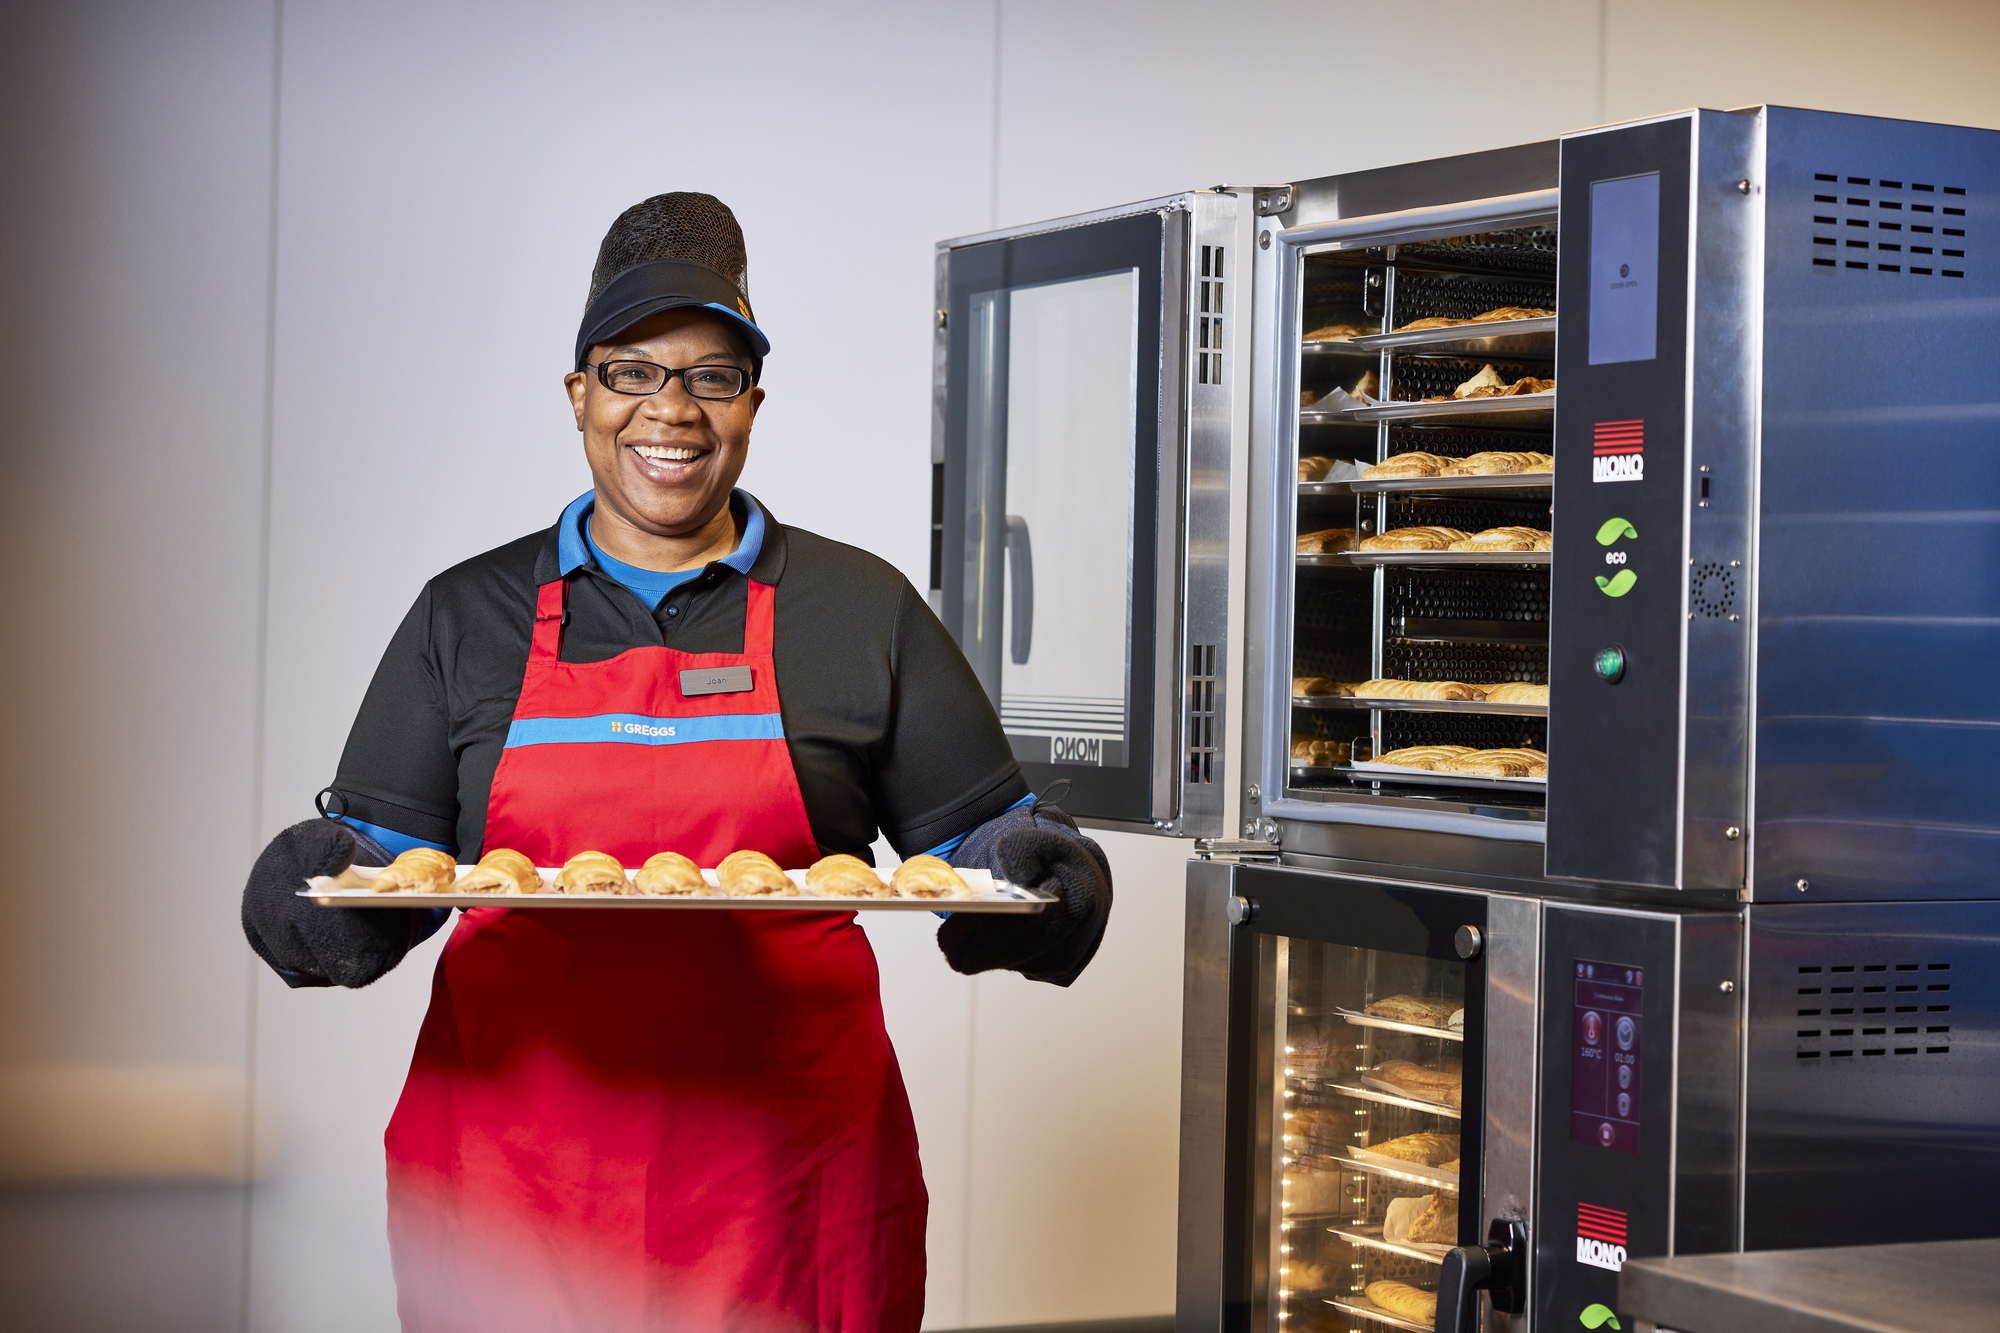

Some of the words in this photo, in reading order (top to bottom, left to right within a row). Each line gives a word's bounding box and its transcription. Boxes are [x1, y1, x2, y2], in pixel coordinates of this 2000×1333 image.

[1593, 453, 1644, 482] MONO
[1605, 551, 1627, 565] eco
[707, 677, 727, 685] Joan
[624, 723, 676, 736] GREGGS
[1581, 1047, 1602, 1060] 160°C
[1614, 1052, 1635, 1065] 01:00
[1577, 1237, 1627, 1272] MONO
